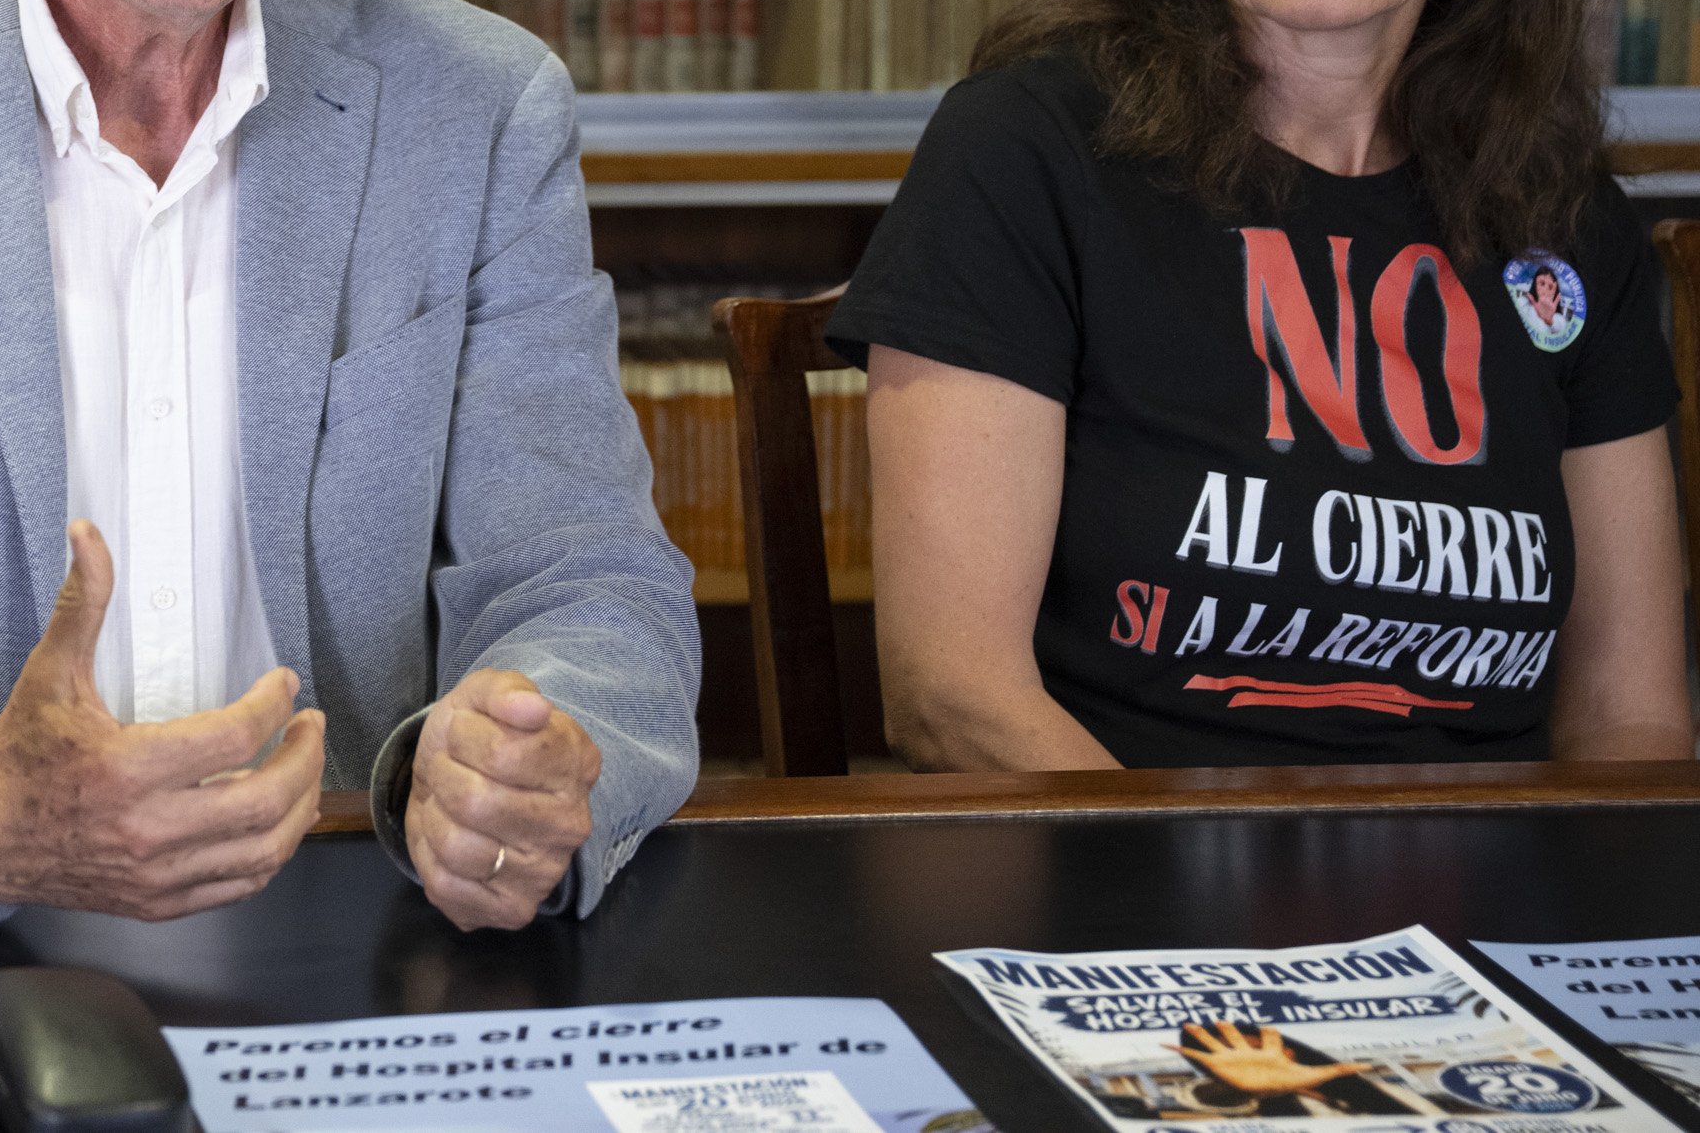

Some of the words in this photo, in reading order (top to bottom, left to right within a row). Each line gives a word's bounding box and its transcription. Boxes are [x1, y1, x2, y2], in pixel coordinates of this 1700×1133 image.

[1239, 227, 1487, 466] NO
[1175, 470, 1283, 576] AL
[1312, 489, 1552, 603] CIERRE
[1110, 579, 1170, 655] SI
[1174, 596, 1219, 657] A
[1225, 603, 1311, 657] LA
[1309, 611, 1557, 691] REFORMA
[975, 946, 1435, 990] MANIFESTACIÓN
[1566, 979, 1651, 994] del
[1065, 993, 1214, 1014] SALVAR
[1219, 991, 1264, 1008] EL
[1085, 1006, 1273, 1030] HOSPITAL
[1281, 997, 1442, 1022] INSULAR
[204, 1033, 457, 1055] Paremos
[479, 1025, 530, 1044] el
[551, 1016, 723, 1040] cierre
[219, 1066, 306, 1082] del
[330, 1053, 573, 1079] Hospital
[598, 1041, 800, 1066] Insular
[819, 1038, 888, 1056] de
[234, 1084, 533, 1110] Lanzarote
[1465, 1072, 1560, 1095] 20
